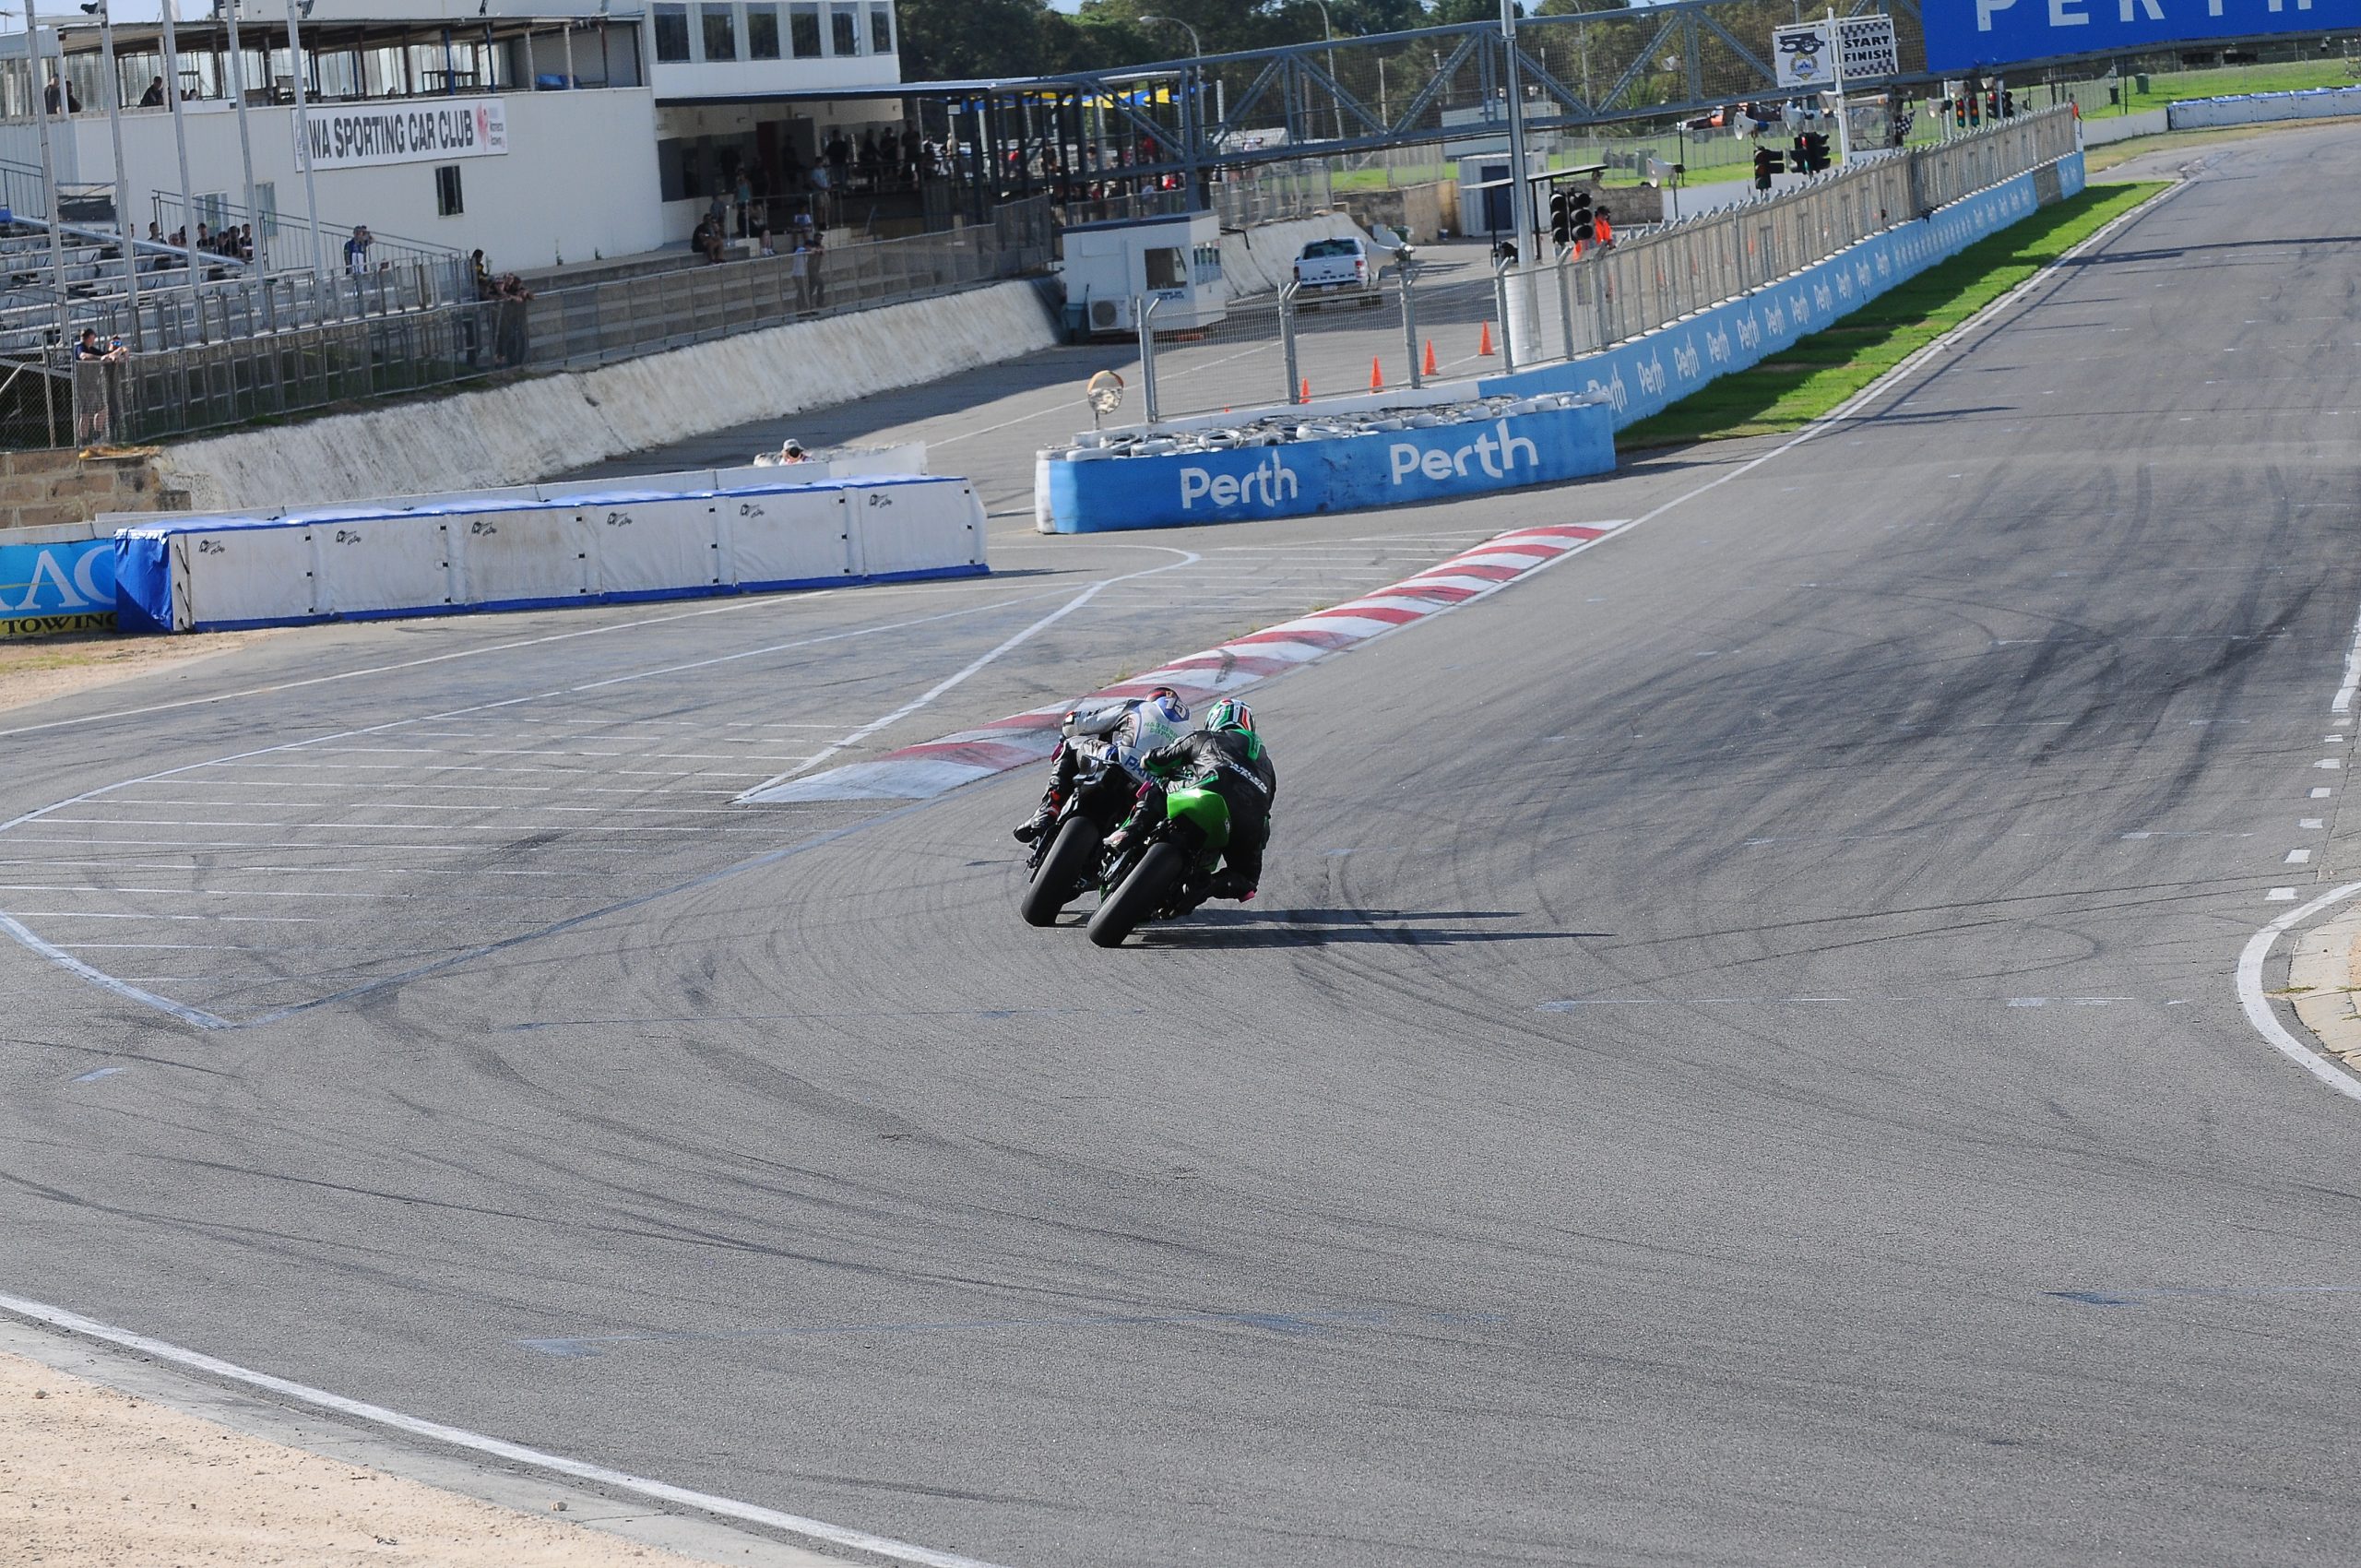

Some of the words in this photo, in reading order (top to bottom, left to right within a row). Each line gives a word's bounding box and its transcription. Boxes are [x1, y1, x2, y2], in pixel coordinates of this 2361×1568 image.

[1845, 35, 1890, 49] START
[1845, 48, 1893, 63] FINISH
[308, 119, 331, 159] WA
[334, 113, 405, 159] SPORTING
[409, 111, 436, 152] CAR
[438, 109, 474, 149] CLUB
[1706, 318, 1731, 363] Perth
[1737, 304, 1761, 350] Perth
[1636, 345, 1667, 397] Perth
[1673, 332, 1701, 381] Perth
[1390, 418, 1539, 485] Perth
[1180, 448, 1299, 509] Perth
[0, 544, 116, 611] AC
